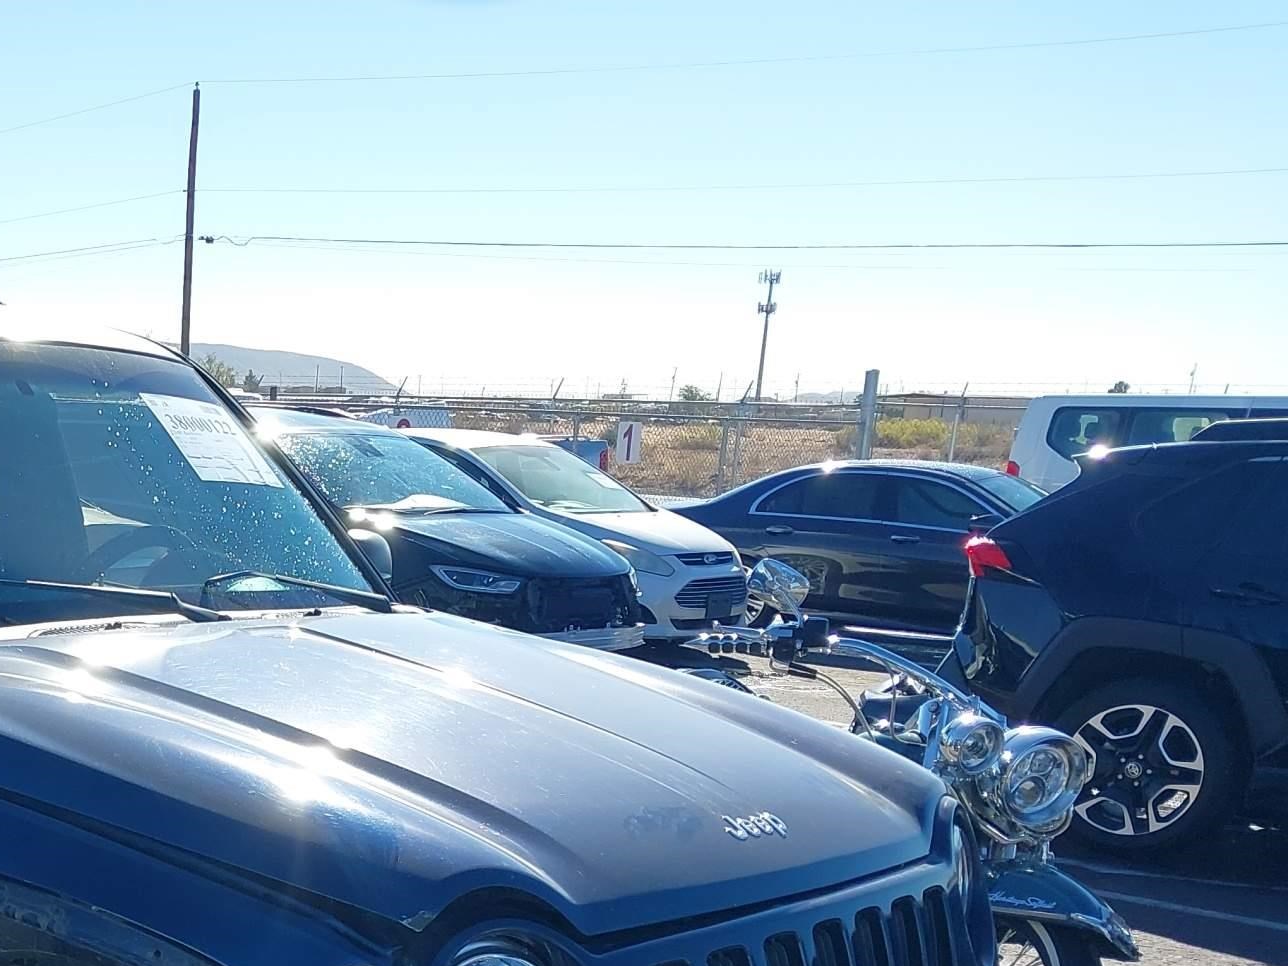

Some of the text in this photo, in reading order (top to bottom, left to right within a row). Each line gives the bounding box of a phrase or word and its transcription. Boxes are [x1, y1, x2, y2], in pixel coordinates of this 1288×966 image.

[164, 414, 237, 435] 38000122
[623, 423, 634, 461] 1
[721, 811, 788, 841] Jeep
